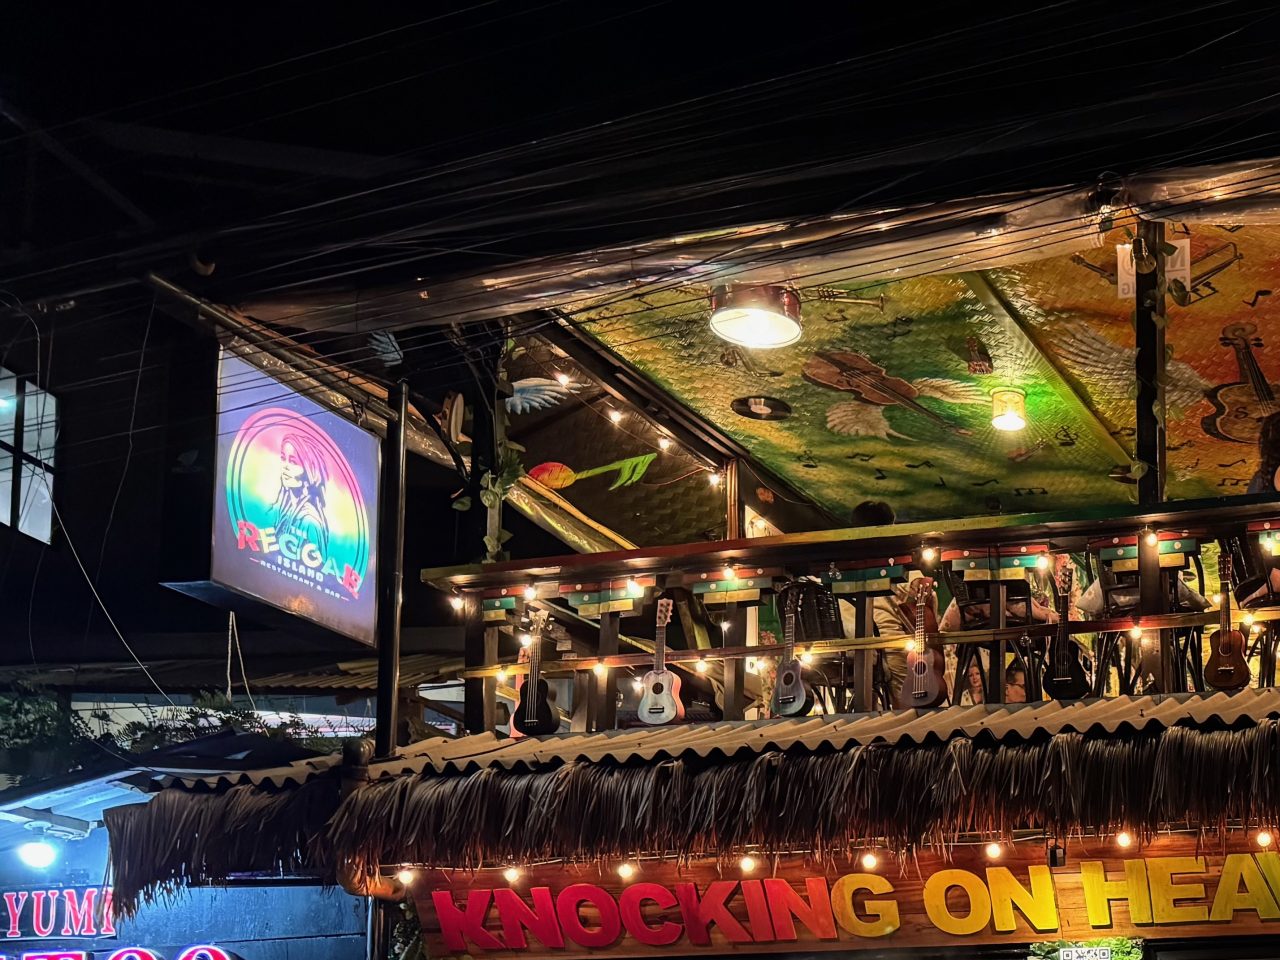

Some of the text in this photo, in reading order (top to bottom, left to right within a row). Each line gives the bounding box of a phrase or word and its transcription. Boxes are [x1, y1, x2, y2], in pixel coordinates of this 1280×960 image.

[237, 520, 359, 600] REGGAE
[260, 560, 314, 588] RESTAURANT
[324, 588, 341, 599] BAR
[277, 555, 324, 583] ISLAND
[432, 872, 900, 952] KNOCKING
[923, 864, 1060, 936] ON
